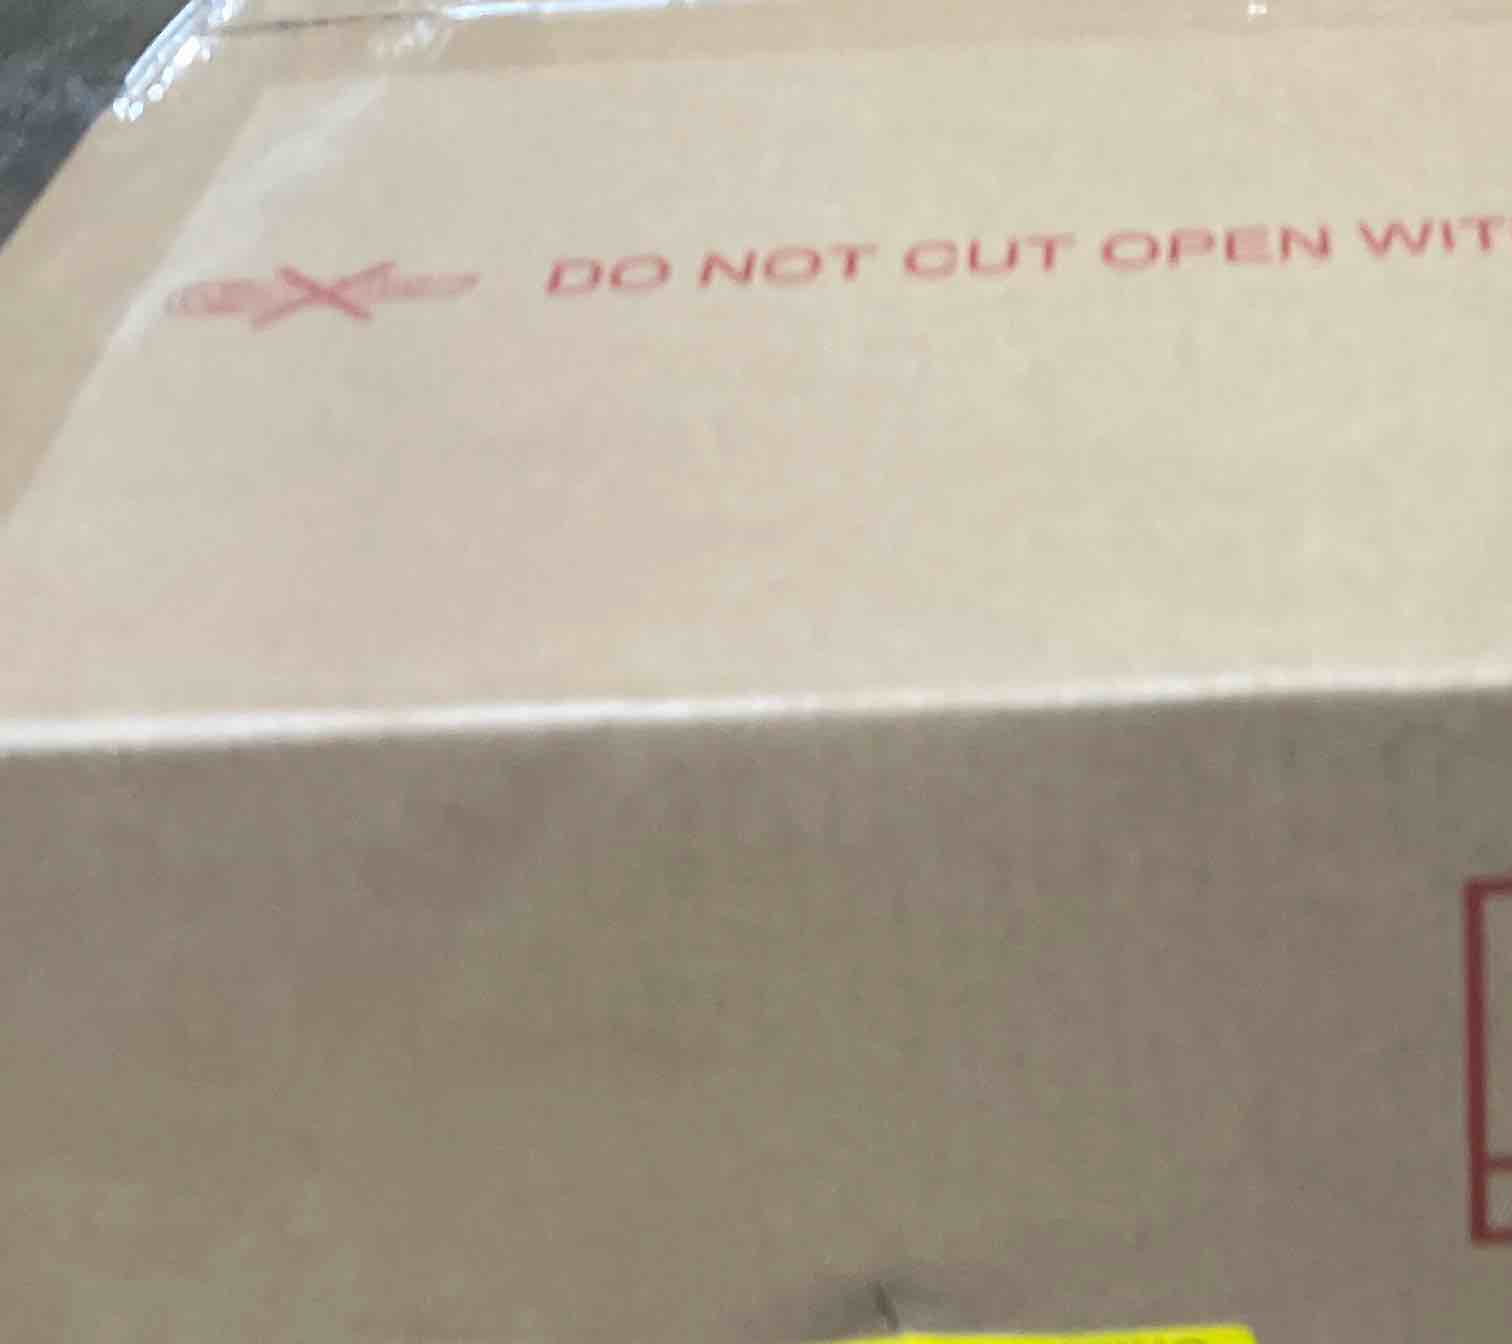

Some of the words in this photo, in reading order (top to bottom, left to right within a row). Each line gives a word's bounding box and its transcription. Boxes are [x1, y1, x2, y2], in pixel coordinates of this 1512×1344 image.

[544, 254, 671, 298] DO
[697, 242, 878, 290] NOT
[902, 232, 1076, 280] CUT
[1099, 222, 1332, 273] OPEN
